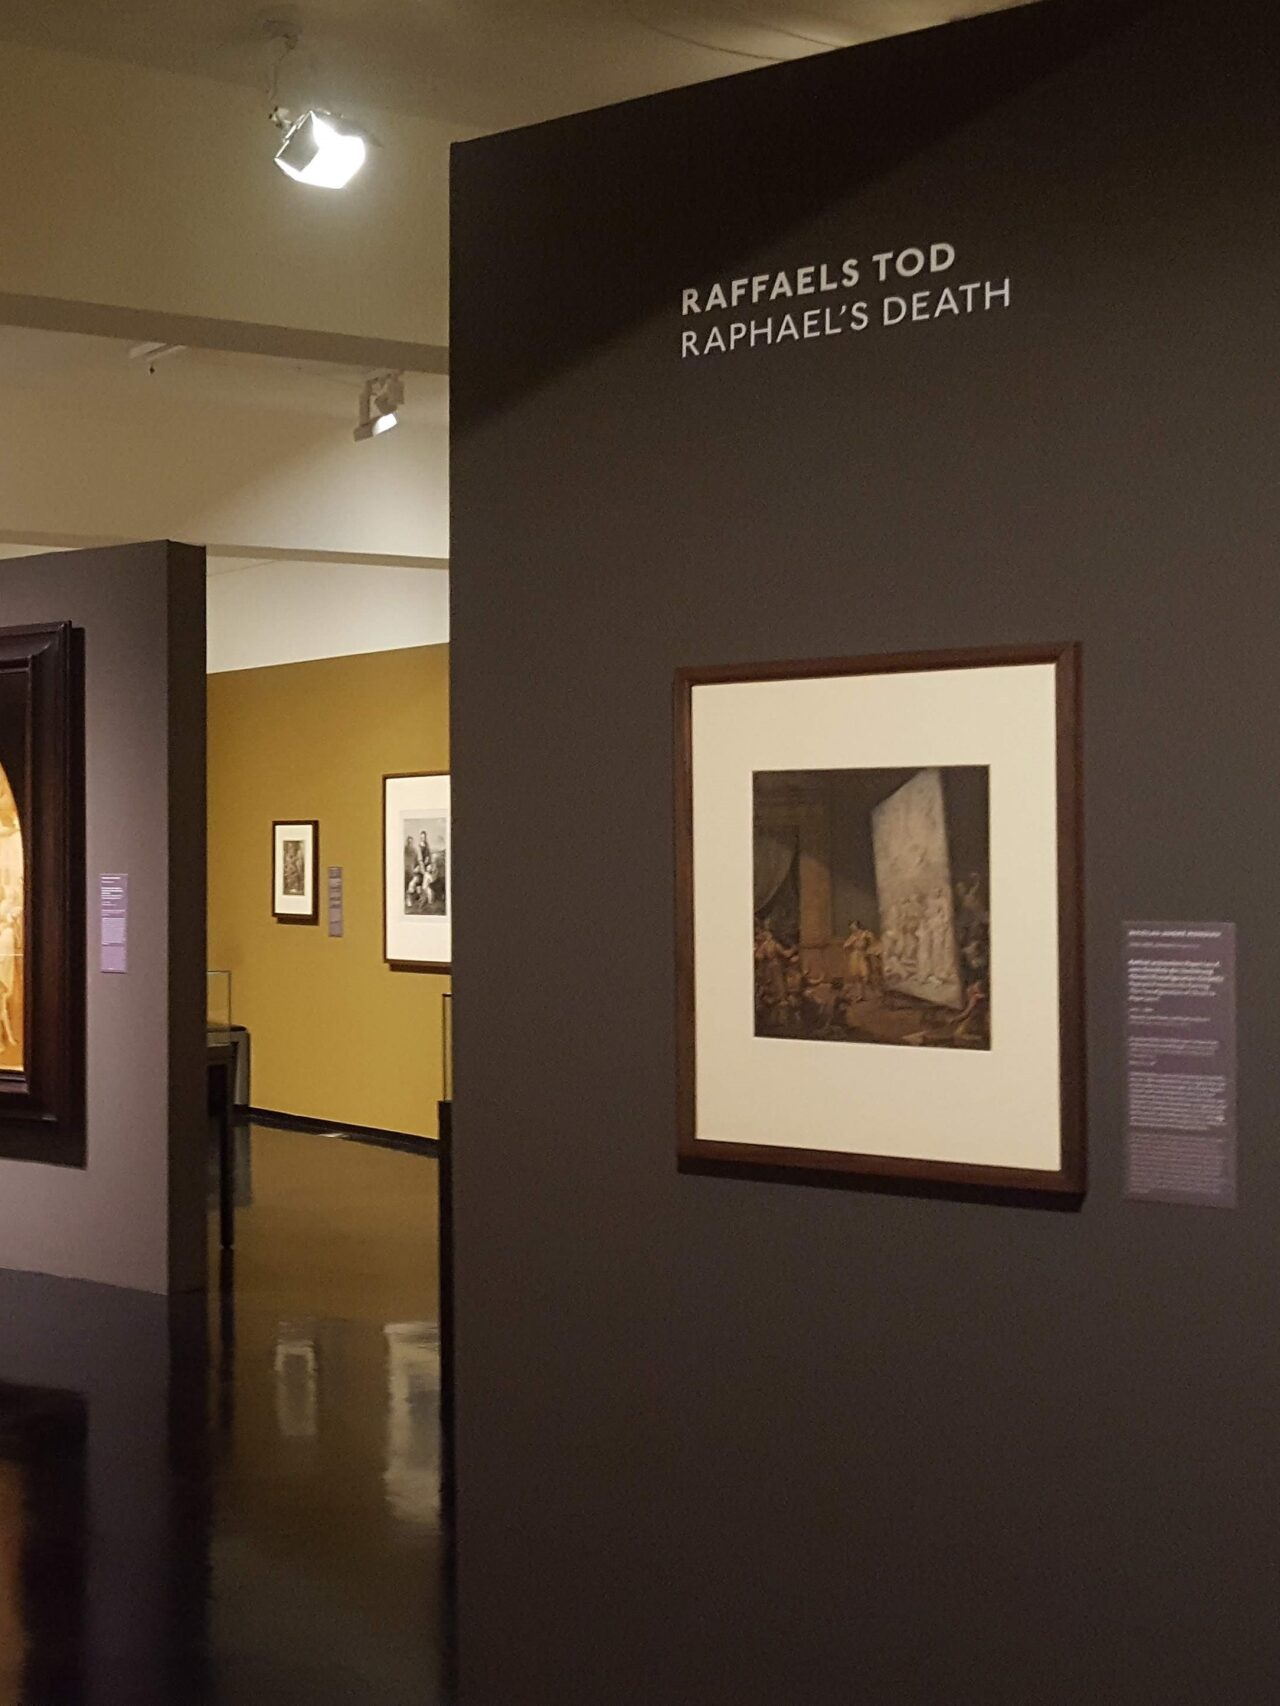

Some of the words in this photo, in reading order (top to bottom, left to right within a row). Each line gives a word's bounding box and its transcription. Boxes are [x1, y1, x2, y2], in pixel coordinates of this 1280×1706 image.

[681, 258, 860, 316] RAFFAELS
[871, 243, 956, 282] TOD
[681, 301, 869, 359] RAPHAEL'S
[882, 277, 1011, 327] DEATH
